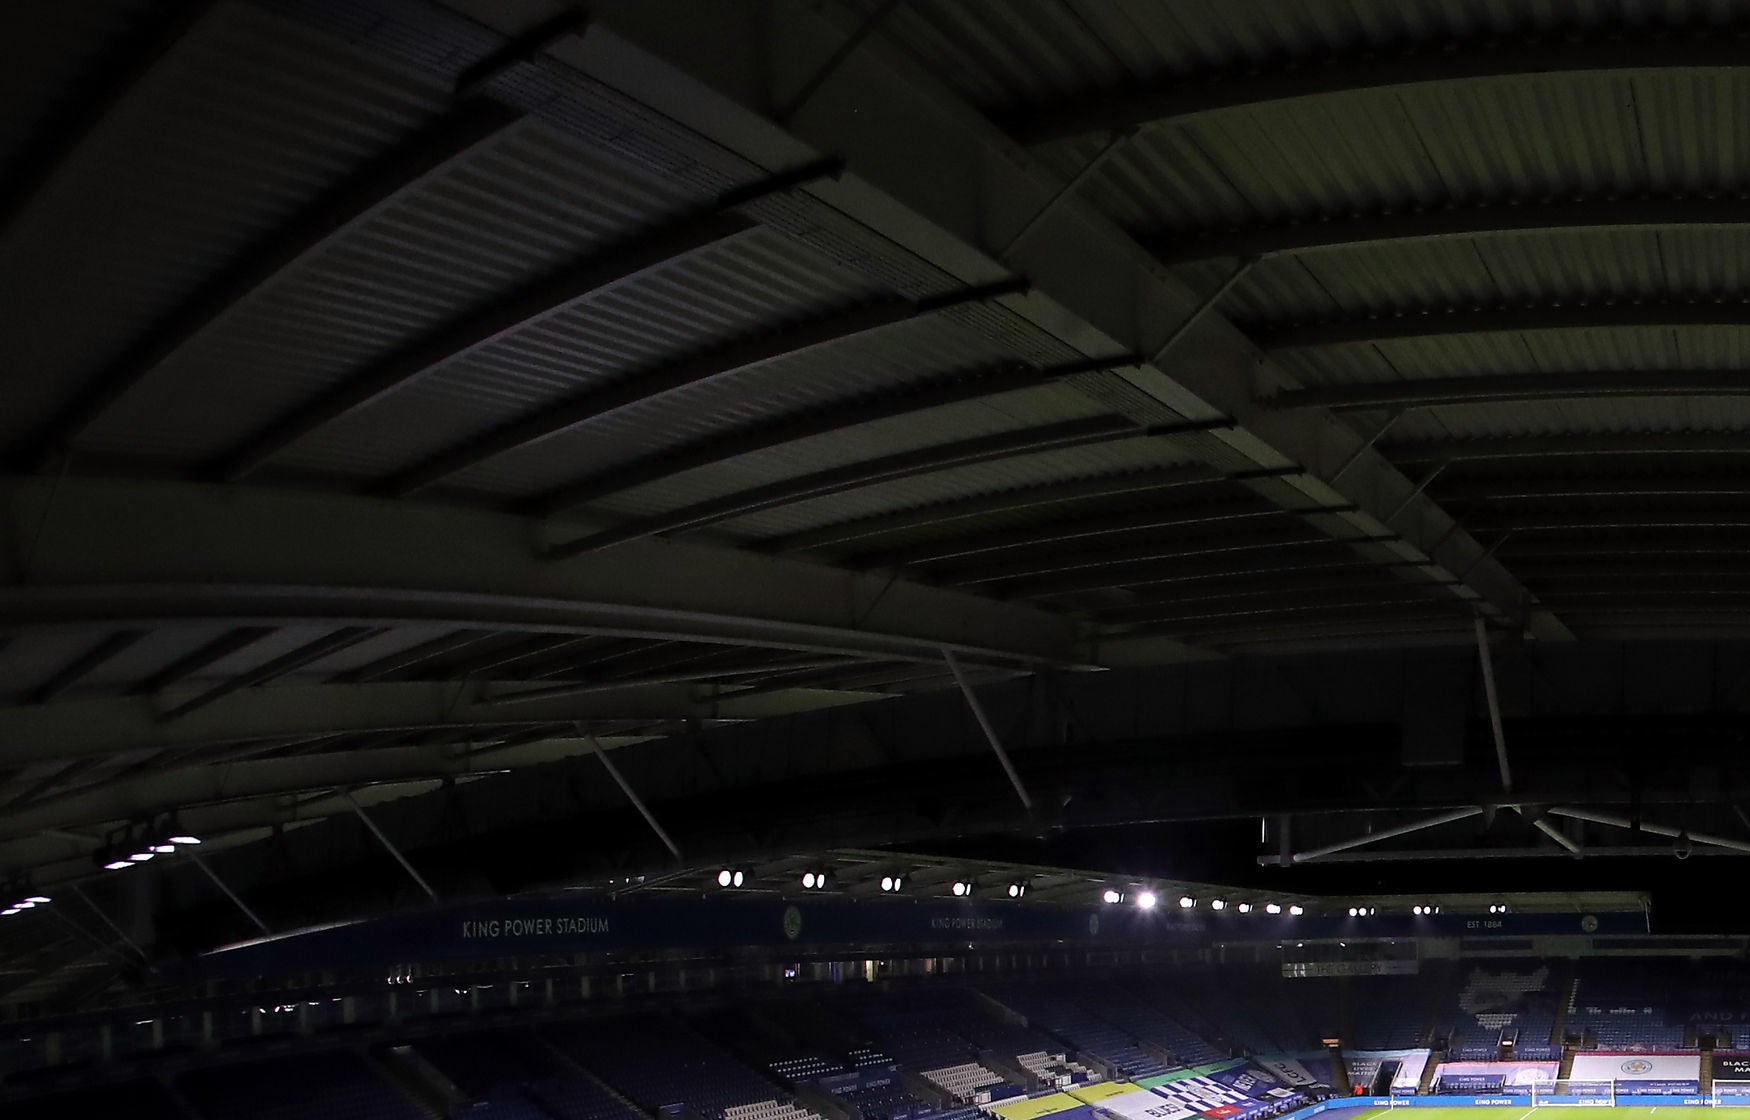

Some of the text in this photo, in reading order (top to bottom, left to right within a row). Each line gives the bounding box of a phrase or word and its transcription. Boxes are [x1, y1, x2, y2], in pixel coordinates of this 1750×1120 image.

[463, 916, 609, 939] KING POWER STADIUM
